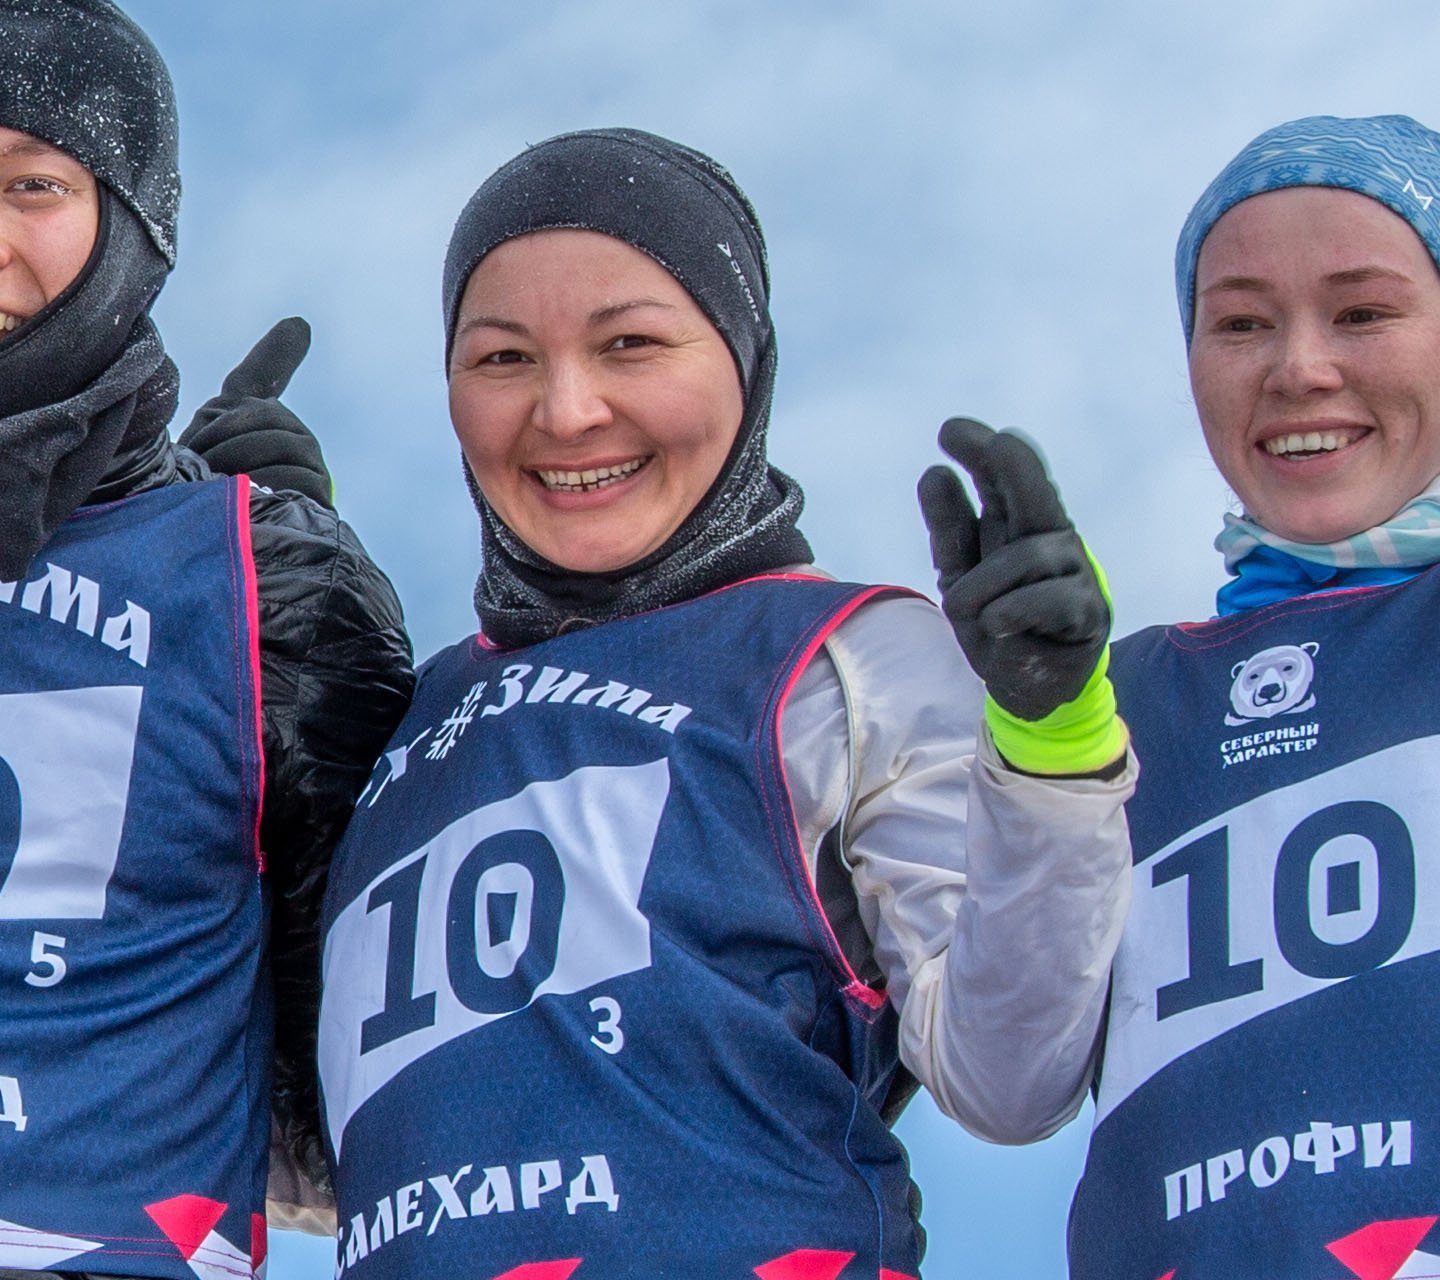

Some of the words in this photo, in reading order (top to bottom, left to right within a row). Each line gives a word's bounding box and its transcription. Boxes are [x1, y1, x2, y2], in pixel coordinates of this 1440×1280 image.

[479, 663, 693, 734] ЗИМА
[1220, 721, 1320, 753] СЕВЕРНЫЙ
[1222, 738, 1318, 770] ХАРАКТЕР
[359, 828, 567, 1057] 10
[1151, 799, 1417, 1023] 10
[23, 930, 68, 989] 5
[588, 996, 625, 1055] 3
[1163, 1119, 1412, 1221] ПРОФИ
